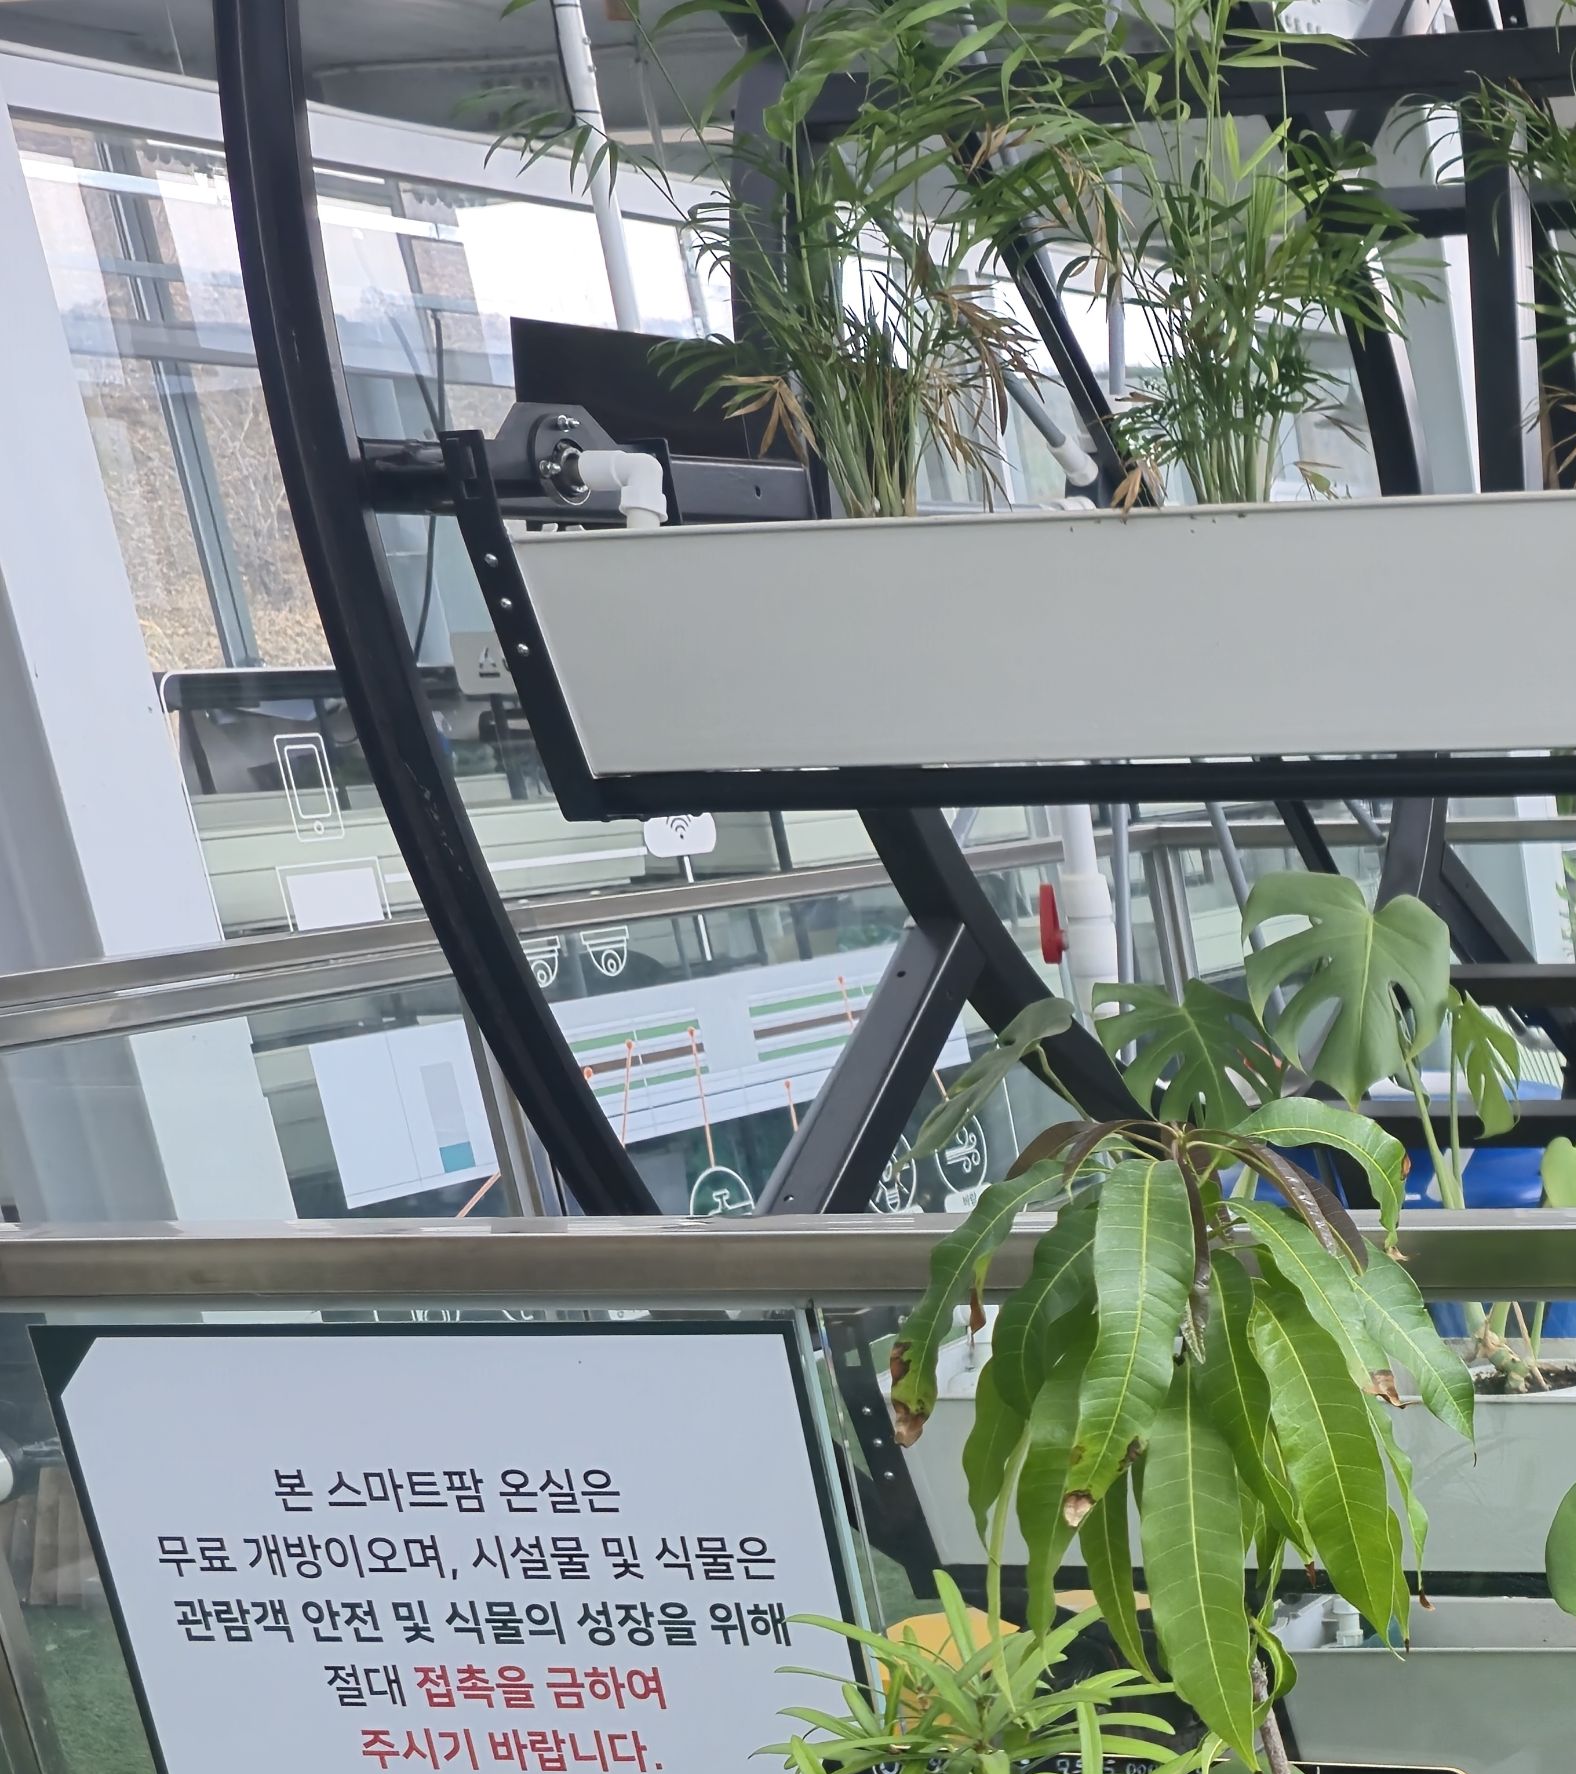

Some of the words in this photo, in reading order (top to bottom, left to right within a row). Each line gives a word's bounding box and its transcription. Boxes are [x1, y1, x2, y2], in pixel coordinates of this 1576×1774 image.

[274, 1468, 314, 1513] 본
[327, 1468, 486, 1513] 스마트팜
[499, 1468, 621, 1514] 온실은
[157, 1536, 238, 1578] 무료
[242, 1534, 458, 1581] 개방이오며,
[472, 1535, 591, 1580] 시설물
[601, 1535, 644, 1580] 및
[655, 1535, 776, 1581] 식물은
[173, 1598, 295, 1643] 관람객
[301, 1599, 384, 1643] 안전
[391, 1600, 435, 1644] 및
[445, 1600, 566, 1645] 식물의
[576, 1601, 697, 1647] 성장을
[709, 1602, 793, 1647] 위해
[323, 1664, 407, 1707] 절대
[413, 1664, 535, 1709] 접촉을
[546, 1666, 667, 1710] 금하여
[361, 1728, 480, 1771] 주시기
[488, 1729, 663, 1773] 바랍니다.
